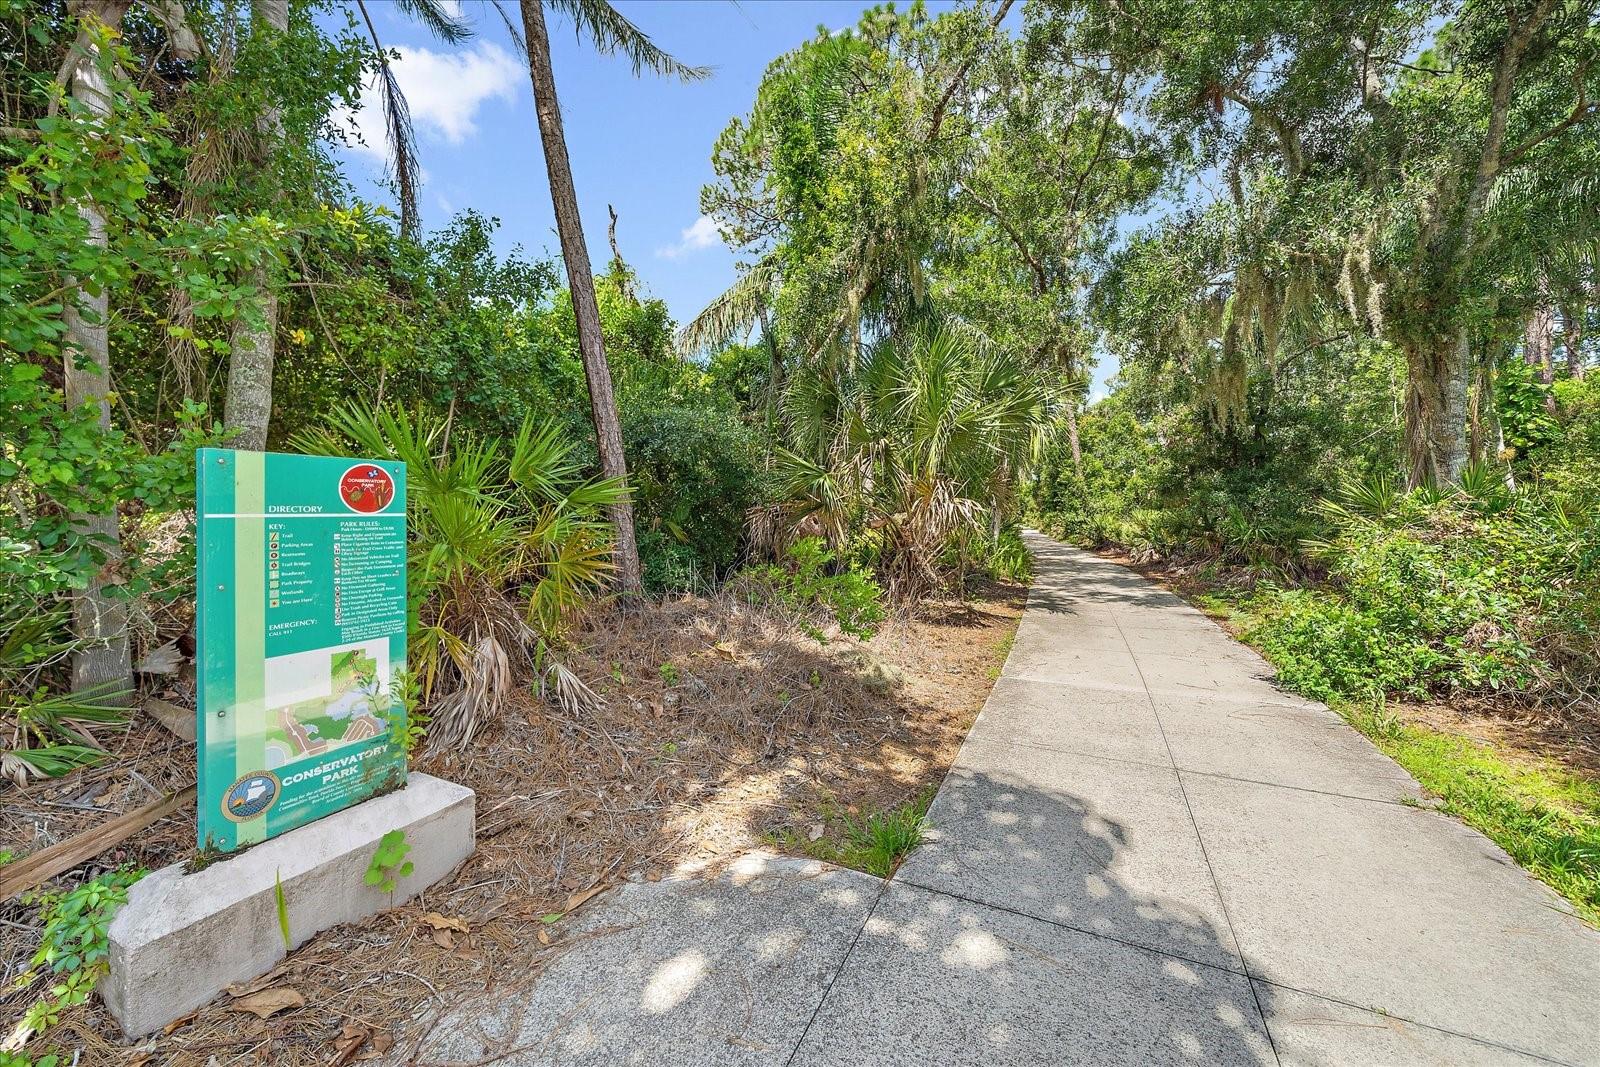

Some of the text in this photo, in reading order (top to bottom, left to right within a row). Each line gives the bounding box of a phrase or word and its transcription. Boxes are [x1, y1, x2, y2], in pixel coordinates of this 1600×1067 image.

[269, 619, 317, 631] EMERGENCY:
[282, 744, 388, 787] CONSERVATORY
[322, 765, 359, 785] PARK
